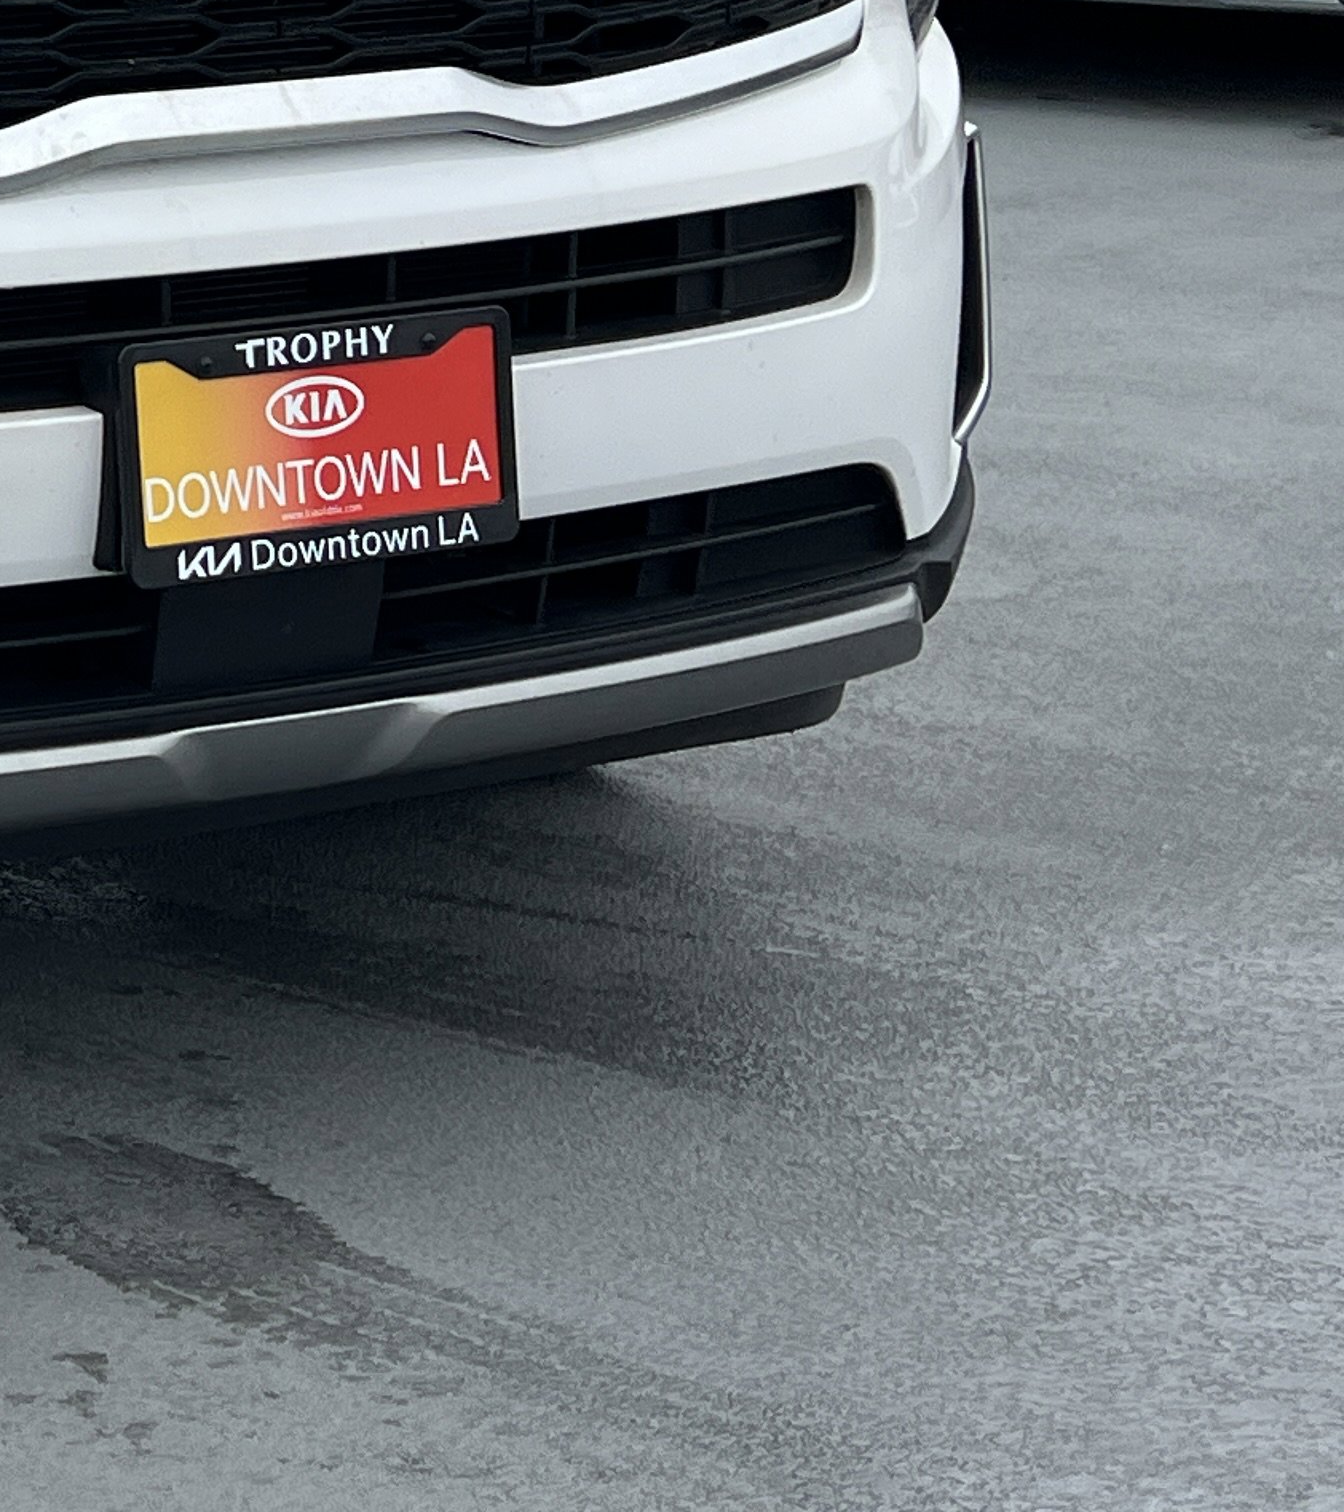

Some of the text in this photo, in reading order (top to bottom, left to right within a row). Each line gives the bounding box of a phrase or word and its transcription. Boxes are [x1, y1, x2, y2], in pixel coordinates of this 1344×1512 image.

[235, 323, 395, 368] TROPHY
[282, 388, 347, 425] KIA
[144, 438, 492, 523] DOWNTOWN LA
[177, 512, 481, 580] KIA Downtown LA
